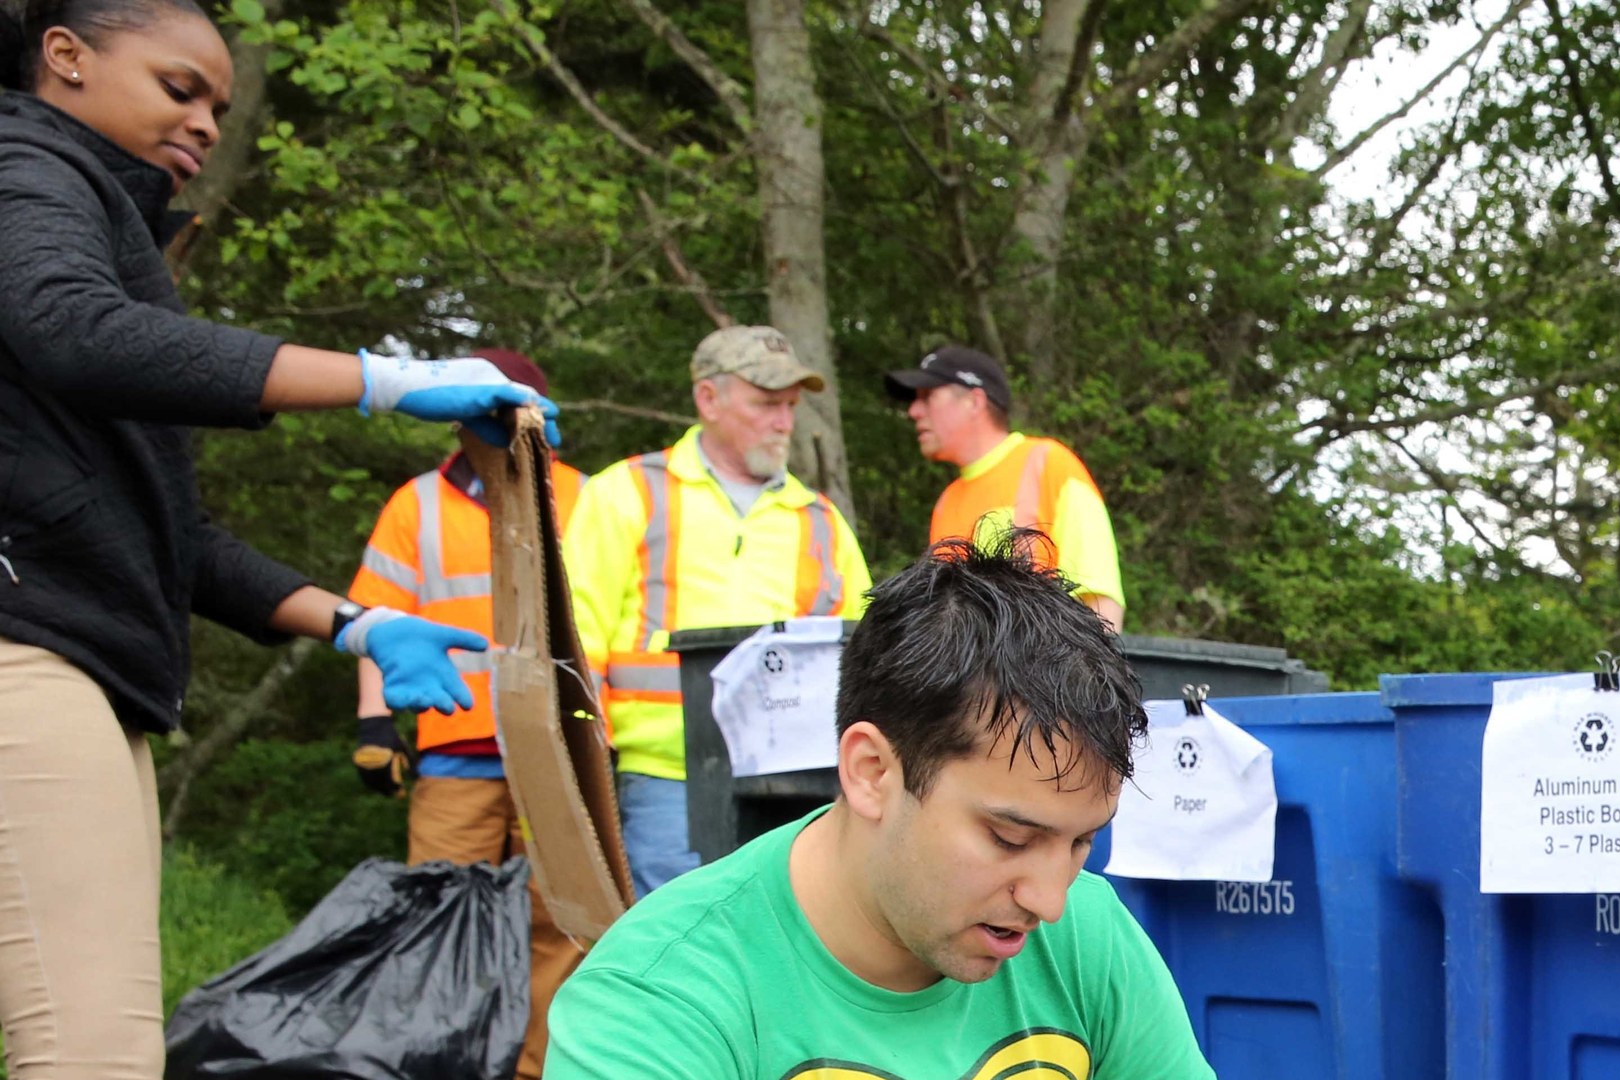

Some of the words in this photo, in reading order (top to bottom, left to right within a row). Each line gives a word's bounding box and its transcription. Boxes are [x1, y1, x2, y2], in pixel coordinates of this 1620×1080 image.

[1534, 777, 1617, 797] Aluminum
[1173, 795, 1207, 814] Paper
[1540, 805, 1596, 825] Plastic
[1544, 836, 1554, 855] 3
[1574, 835, 1584, 854] 7
[1215, 880, 1295, 915] R267575
